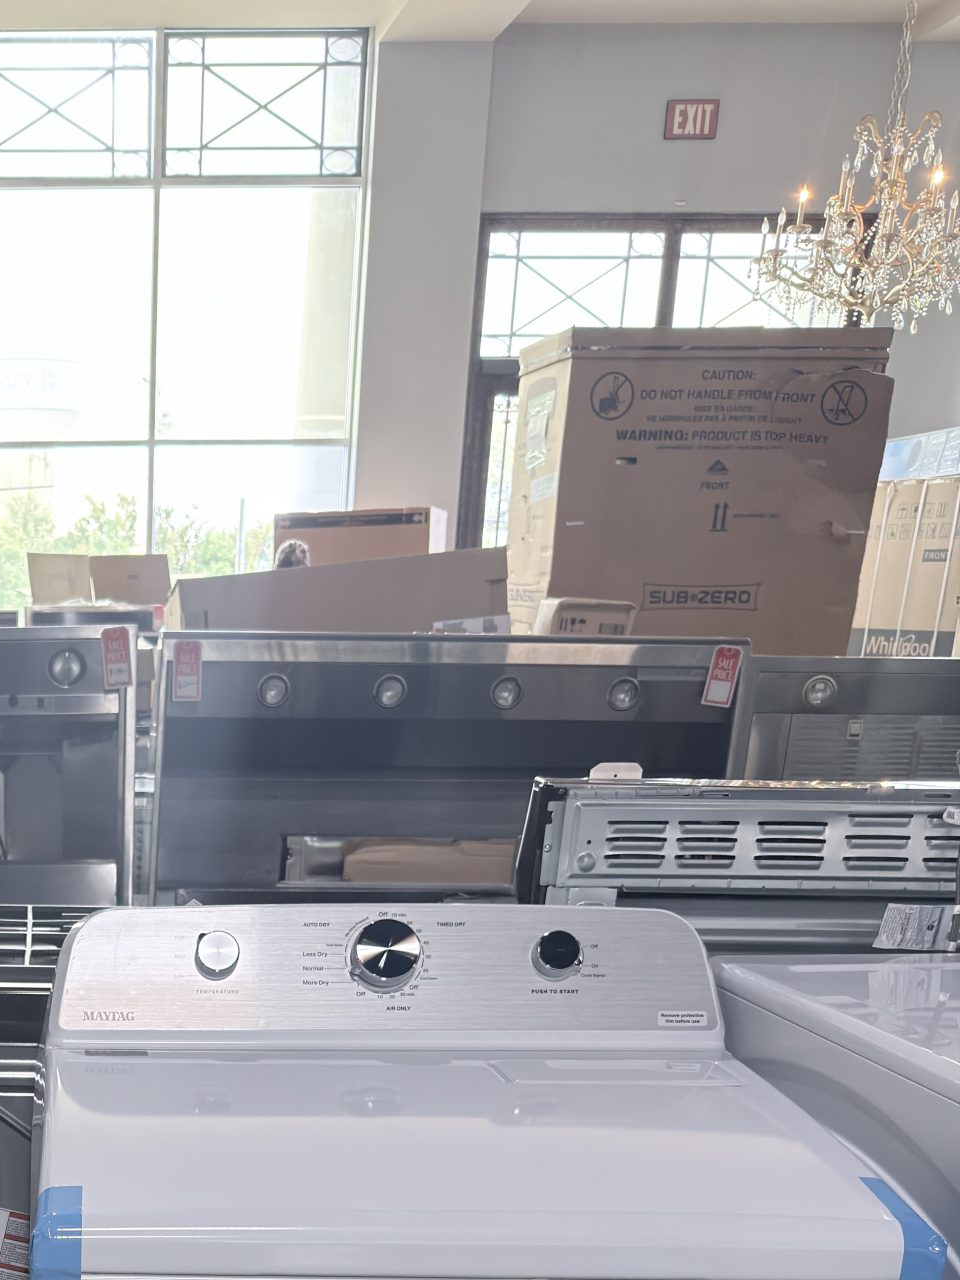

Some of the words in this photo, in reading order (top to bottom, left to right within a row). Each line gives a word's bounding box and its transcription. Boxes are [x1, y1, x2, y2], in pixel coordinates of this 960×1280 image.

[672, 103, 715, 135] EXIT
[701, 369, 757, 381] CAUTION:
[640, 389, 657, 400] DO
[660, 389, 684, 400] NOT
[687, 389, 735, 400] HANDLE
[737, 389, 773, 401] FROM
[774, 391, 816, 404] FRONT
[615, 429, 689, 441] WARNING:
[691, 430, 746, 441] PRODUCT
[750, 430, 761, 441] IS
[764, 431, 787, 442] TOP
[789, 433, 829, 445] HEAVY
[700, 481, 730, 491] FRONT
[718, 657, 735, 669] SALE
[713, 669, 732, 680] PRICE
[317, 951, 328, 959] Dry
[319, 979, 330, 987] Dry
[83, 1011, 135, 1022] MAYTAG
[680, 1012, 704, 1020] protective
